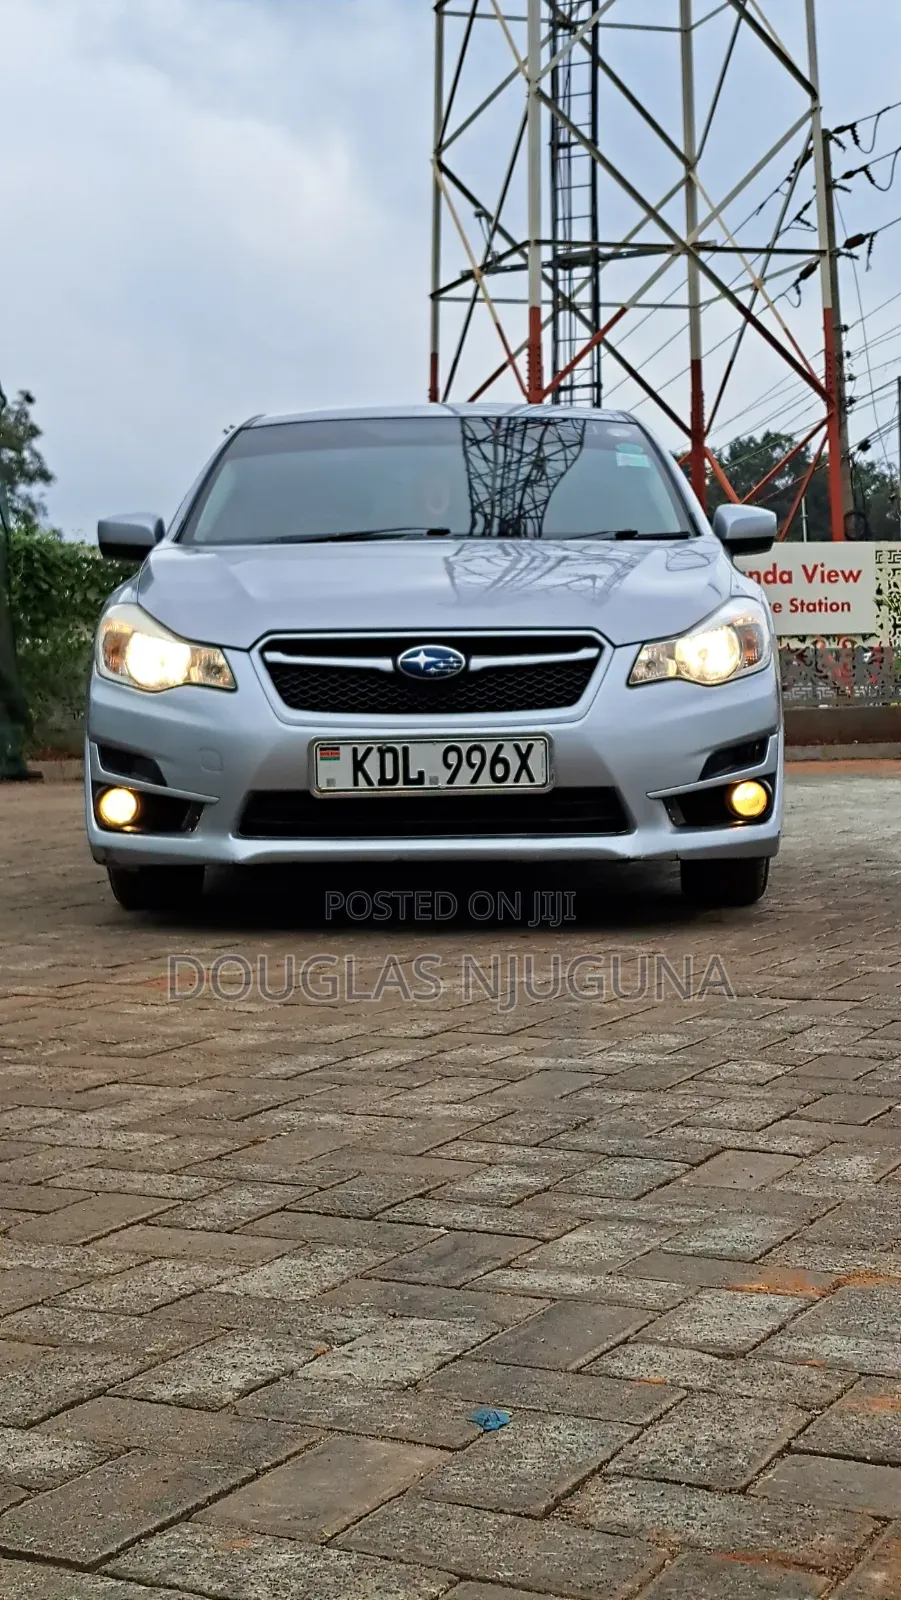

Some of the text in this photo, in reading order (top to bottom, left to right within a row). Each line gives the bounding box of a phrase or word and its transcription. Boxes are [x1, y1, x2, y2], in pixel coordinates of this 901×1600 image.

[744, 562, 862, 585] nda View
[789, 597, 851, 613] Station
[352, 745, 425, 787] KDL
[442, 742, 536, 785] 996X
